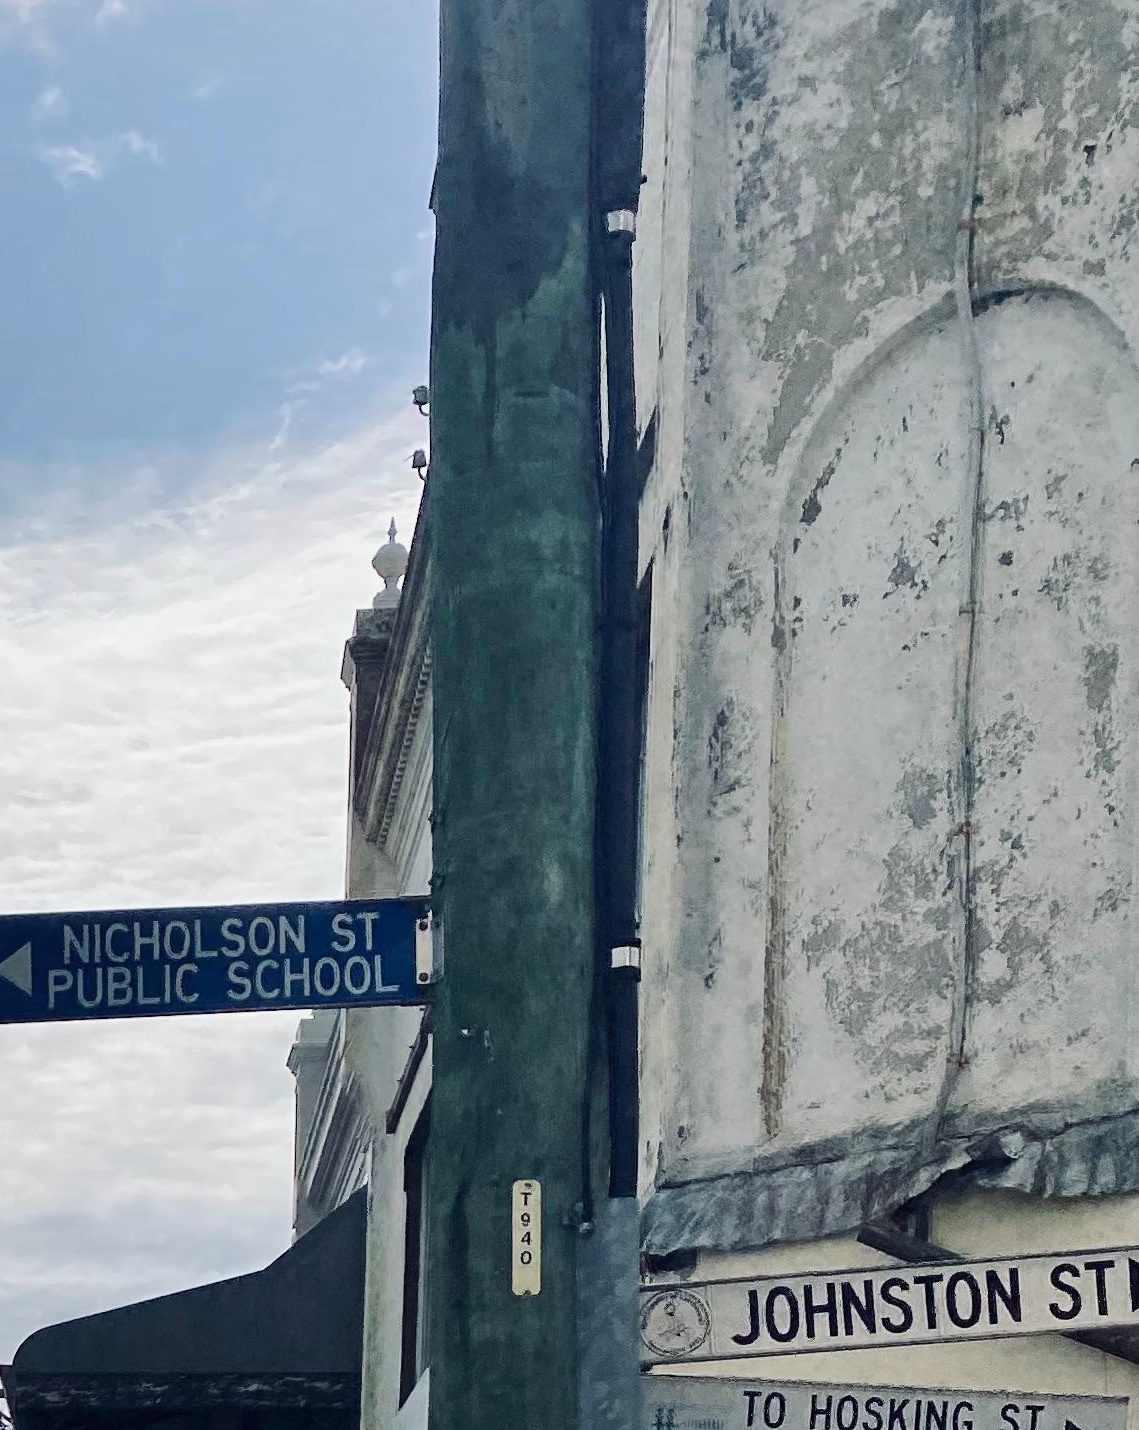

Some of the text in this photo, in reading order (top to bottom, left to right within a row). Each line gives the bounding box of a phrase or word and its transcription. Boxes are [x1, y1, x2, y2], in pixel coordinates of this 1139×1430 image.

[62, 911, 380, 964] NICHOLSON ST
[47, 954, 401, 1010] PUBLIC SCHOOL
[520, 1192, 533, 1266] T940
[731, 1266, 1023, 1346] JOHNSTON
[1048, 1259, 1116, 1321] ST
[743, 1390, 786, 1429] TO
